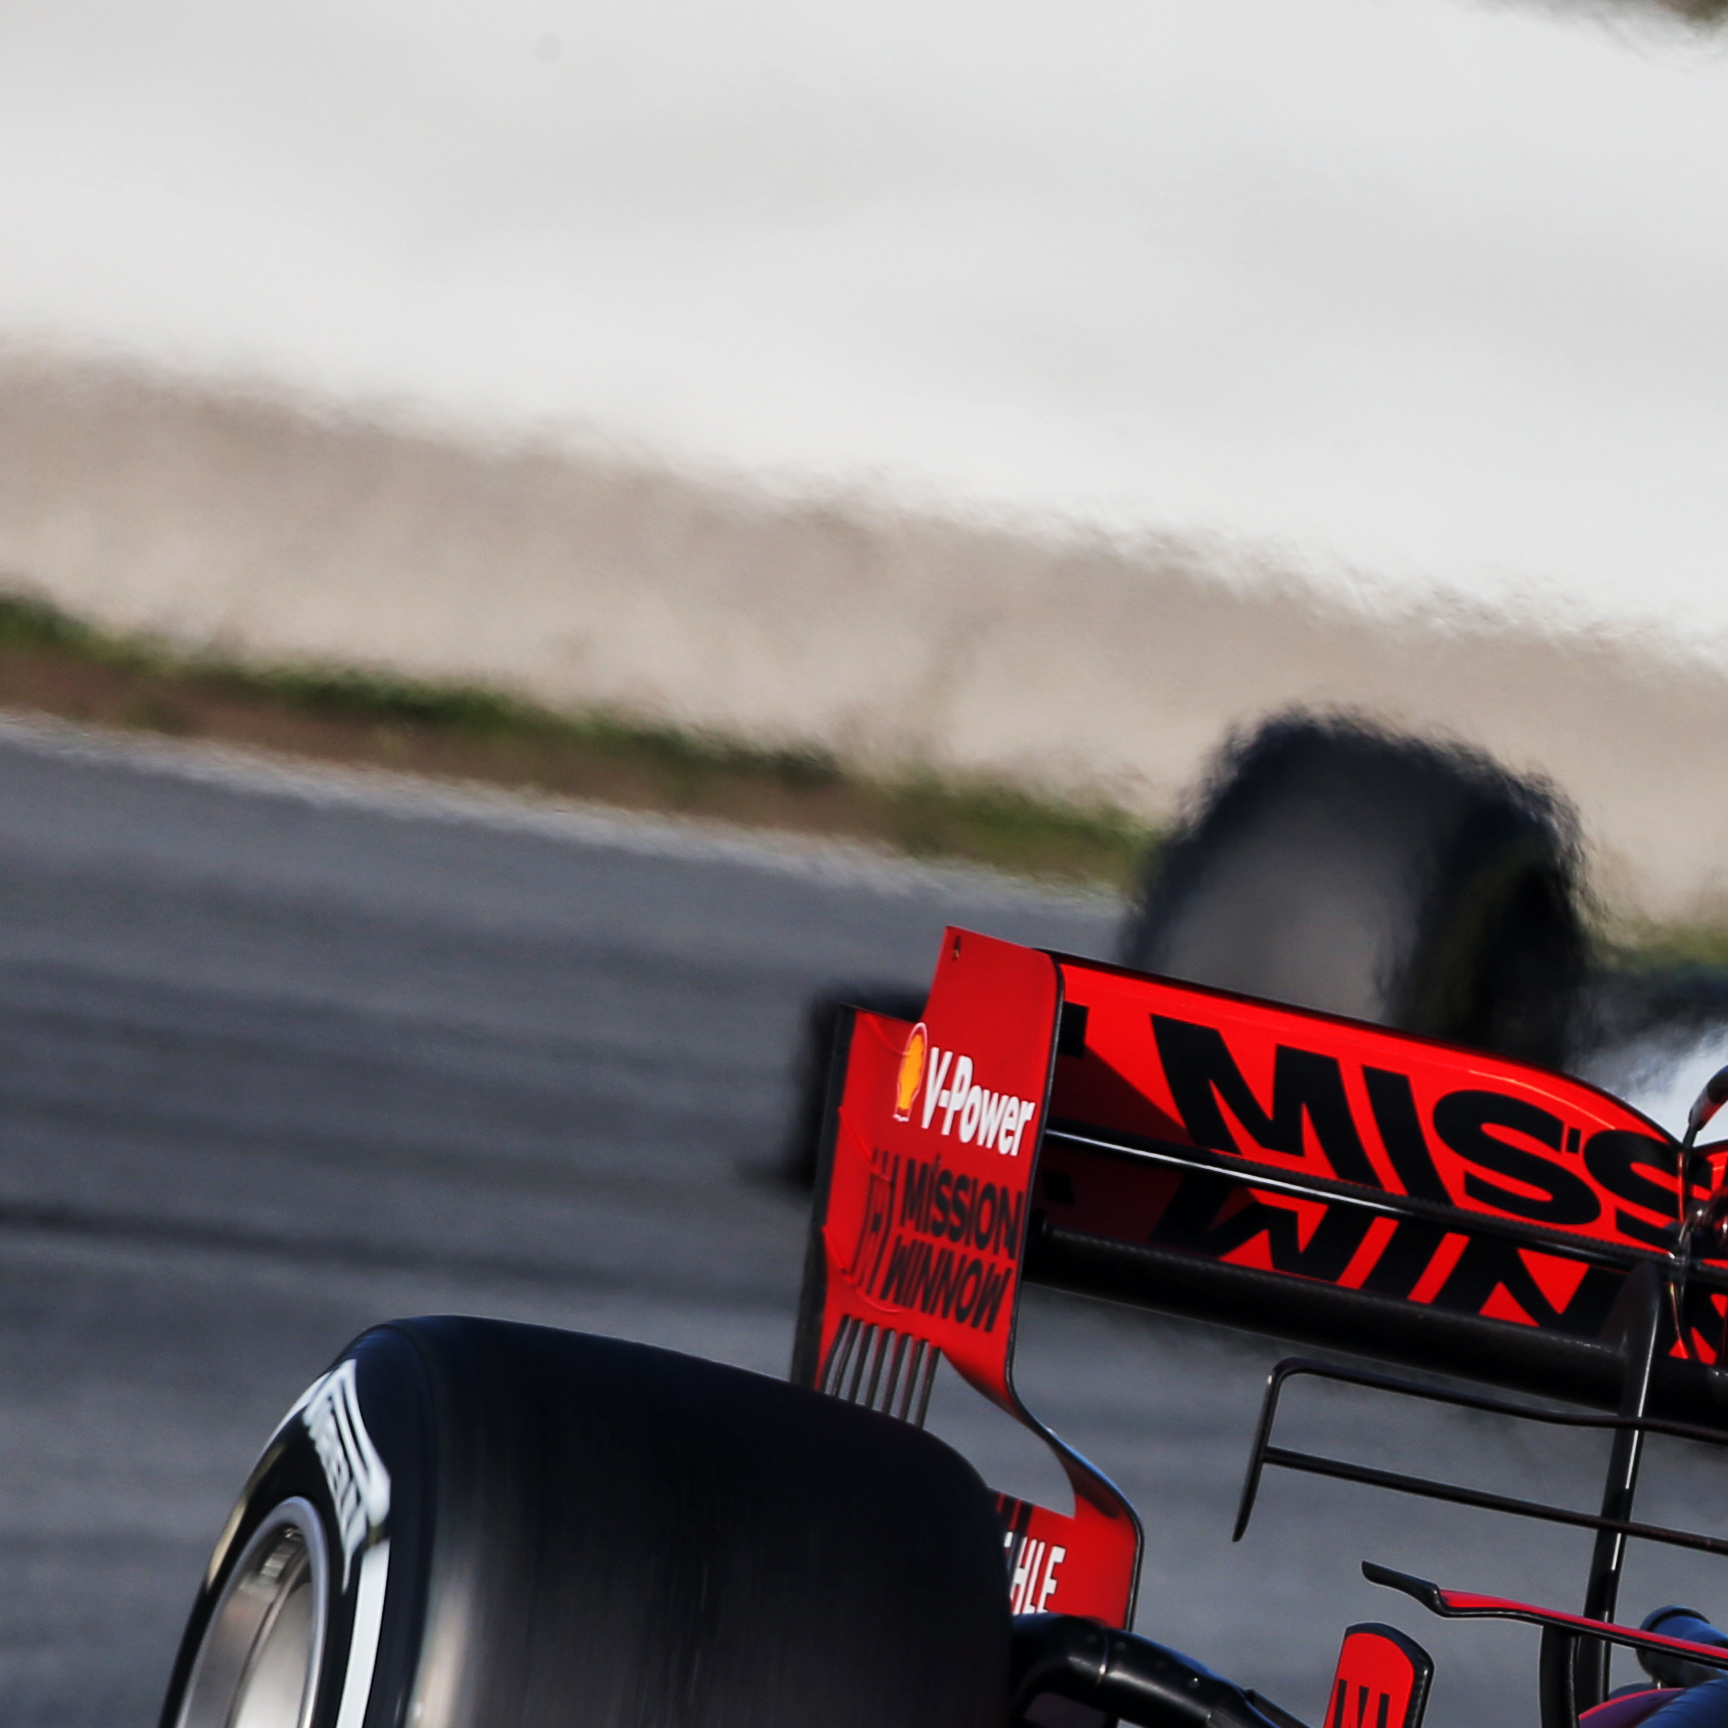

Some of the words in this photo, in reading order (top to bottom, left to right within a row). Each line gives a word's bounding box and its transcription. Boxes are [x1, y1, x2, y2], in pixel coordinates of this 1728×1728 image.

[921, 1047, 1036, 1156] V-Power
[900, 1158, 1025, 1260] MISSION
[880, 1235, 1013, 1333] WINNOW
